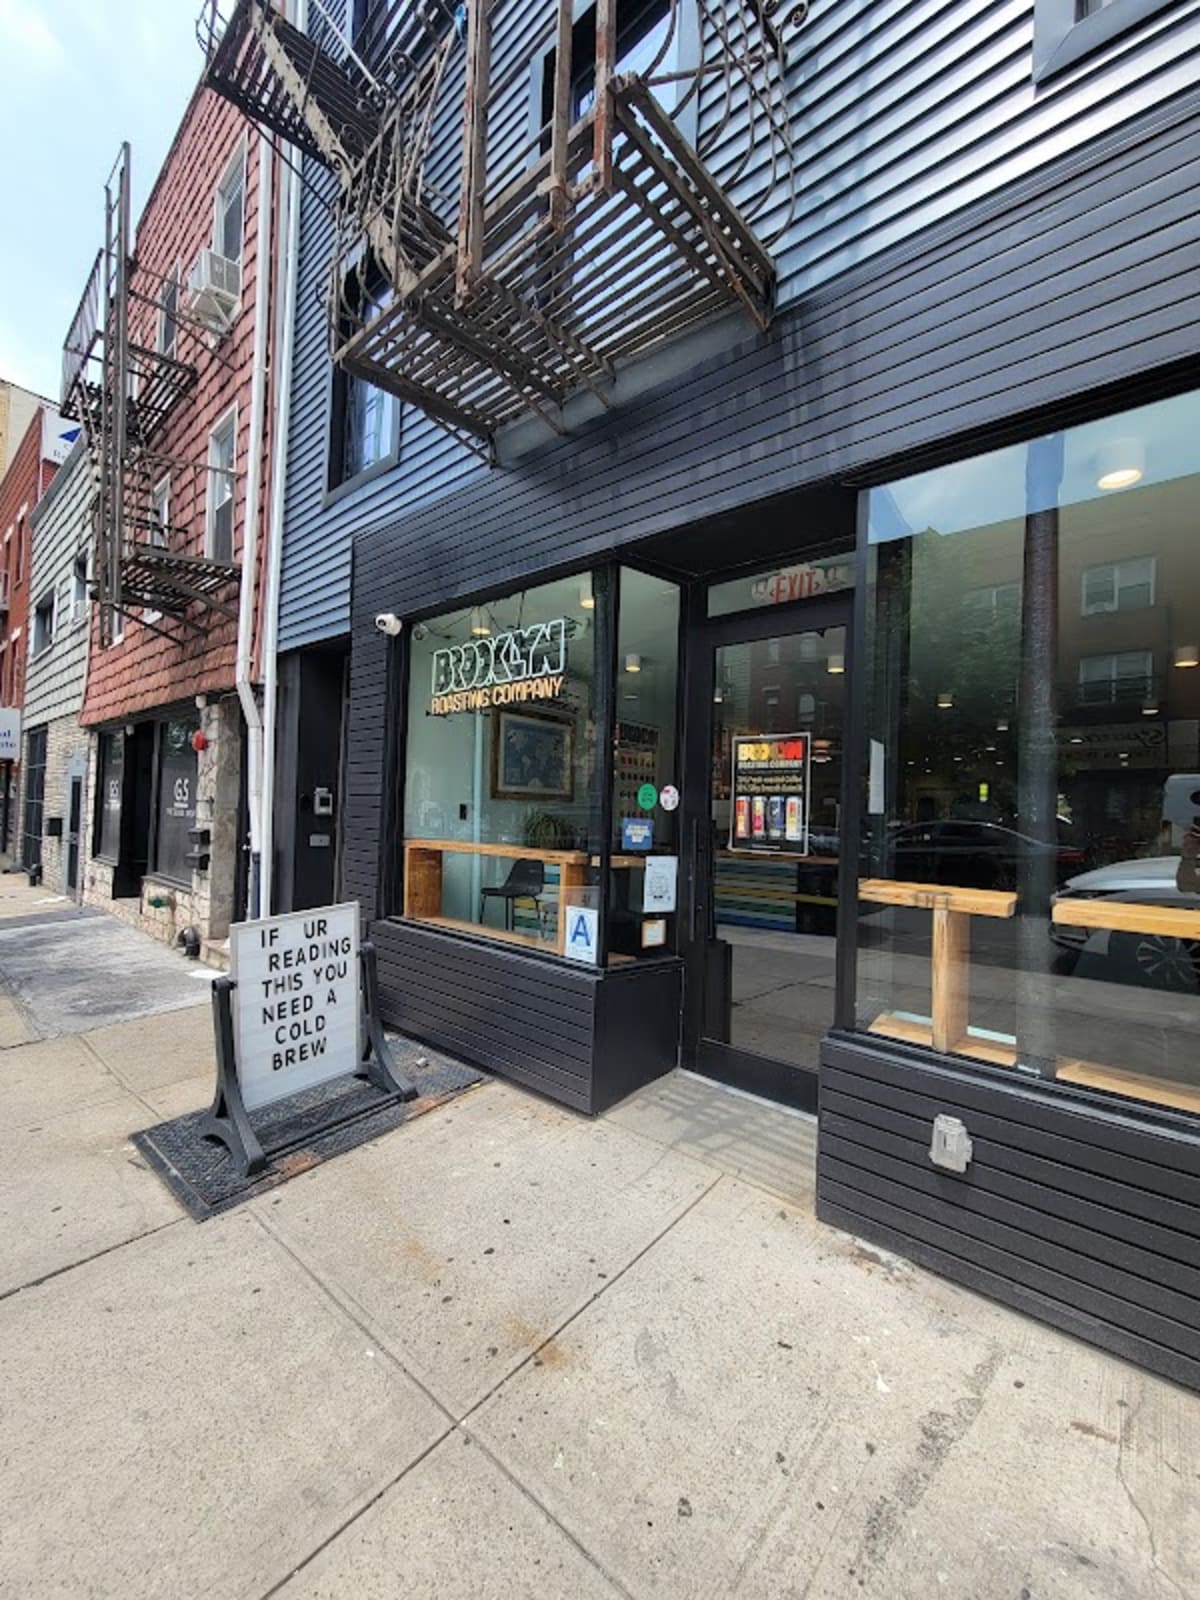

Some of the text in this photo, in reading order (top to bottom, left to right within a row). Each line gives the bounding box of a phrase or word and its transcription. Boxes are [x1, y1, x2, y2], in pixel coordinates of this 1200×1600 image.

[773, 570, 817, 604] EXIT
[432, 619, 565, 697] BROOKLYN
[431, 676, 564, 715] ROASTING COMPANY
[261, 919, 328, 948] IF UR
[571, 914, 591, 947] A
[269, 937, 351, 972] READING
[261, 961, 347, 998] THIS YOU
[262, 988, 337, 1024] NEED A
[275, 1015, 326, 1045] COLD
[272, 1037, 327, 1071] BREW
